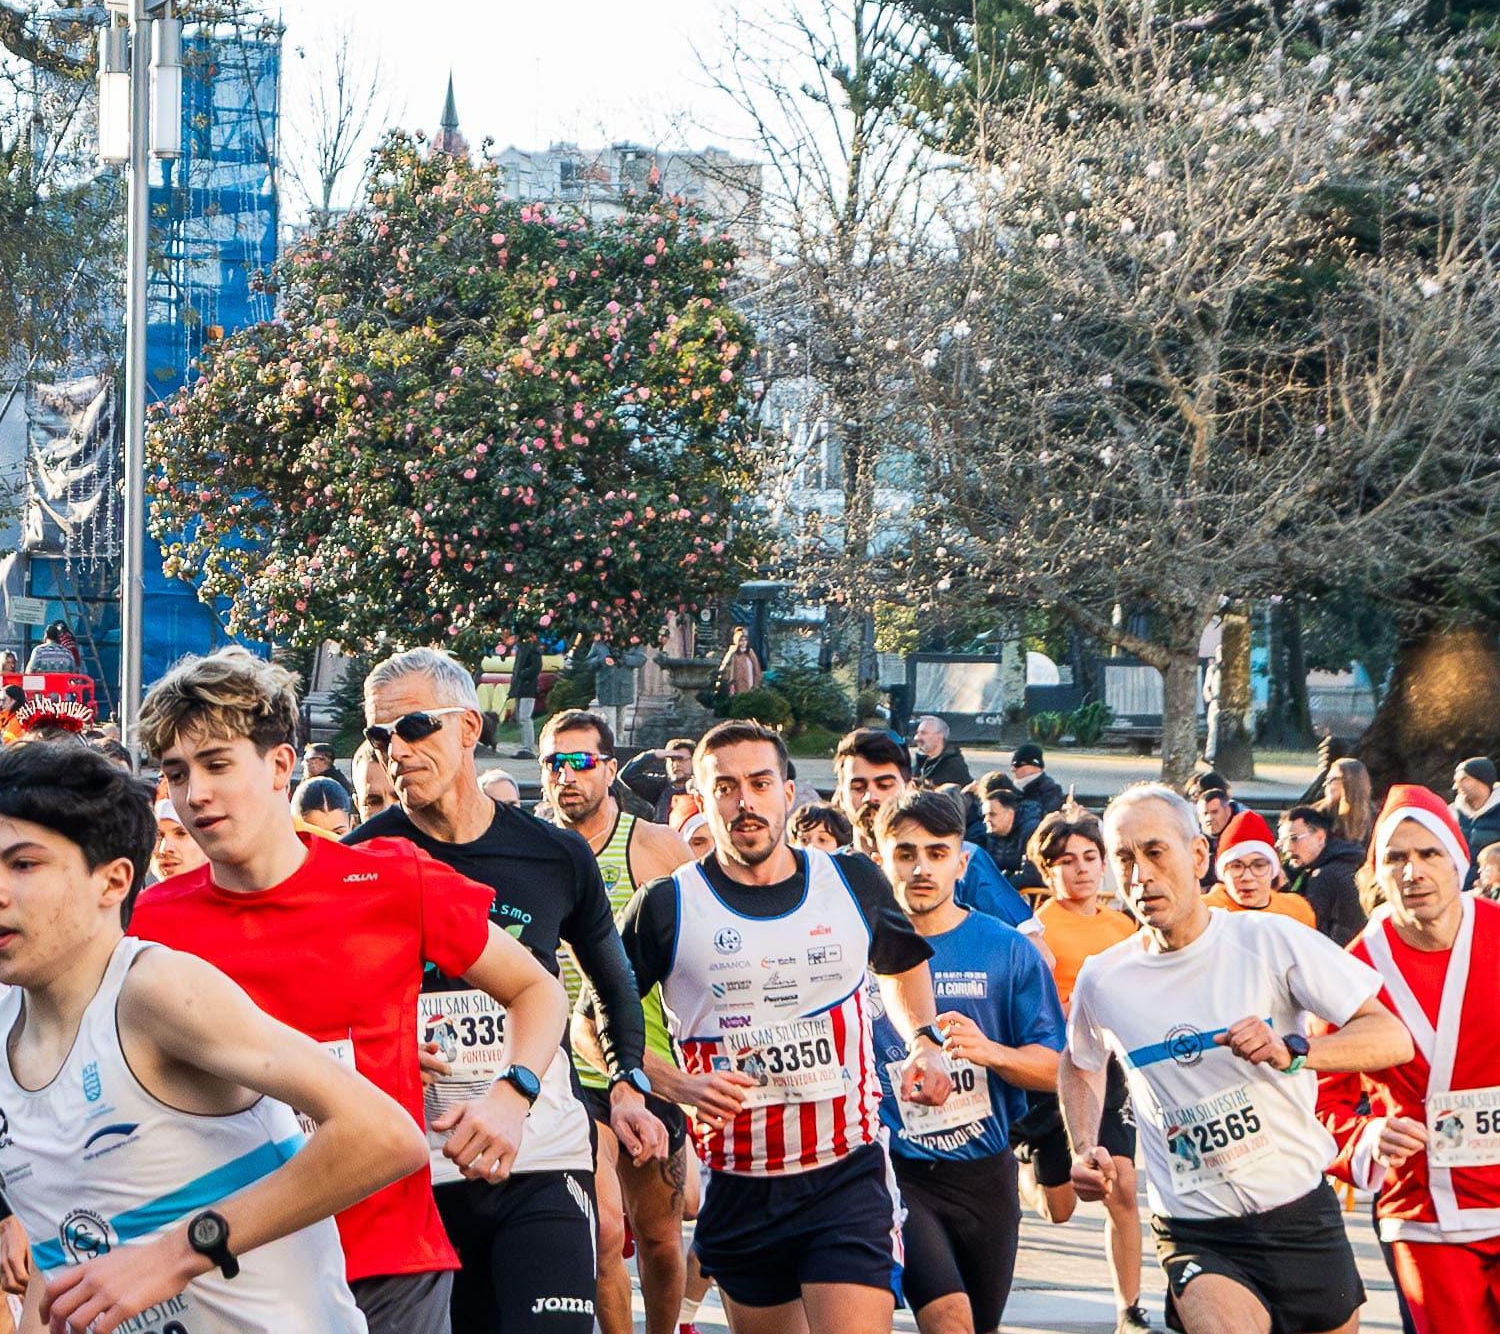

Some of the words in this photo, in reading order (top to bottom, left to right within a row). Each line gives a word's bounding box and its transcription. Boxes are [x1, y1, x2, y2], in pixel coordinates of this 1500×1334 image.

[937, 982, 945, 995] A
[946, 980, 983, 996] CORUÑA
[446, 995, 469, 1014] SAN
[752, 1028, 774, 1047] SAN
[776, 1019, 826, 1041] SILVESTRE
[767, 1038, 832, 1073] 3350
[1177, 1107, 1197, 1126] SAN
[1196, 1086, 1250, 1120] SILVESTRE
[1193, 1105, 1261, 1154] 2565
